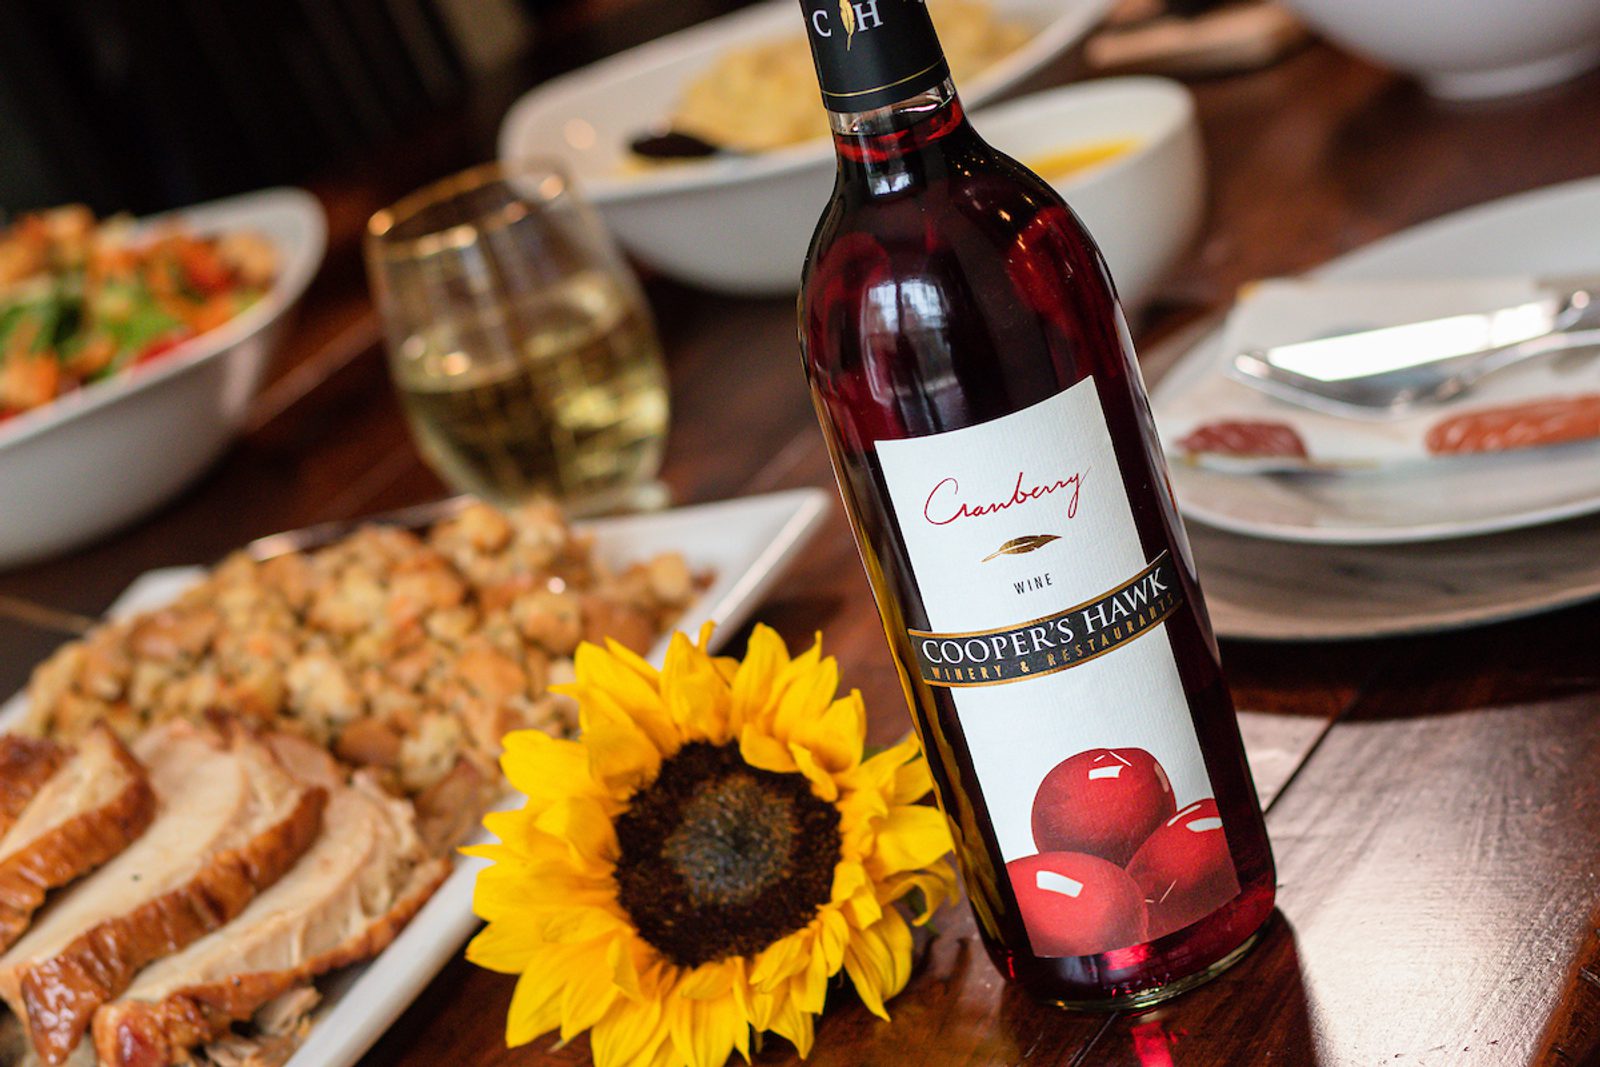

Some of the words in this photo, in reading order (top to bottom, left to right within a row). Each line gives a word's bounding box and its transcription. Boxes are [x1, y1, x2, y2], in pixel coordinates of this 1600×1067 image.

[812, 9, 832, 38] C
[852, 0, 884, 32] H
[924, 466, 1091, 525] Cranberry
[1013, 572, 1053, 595] WINE
[922, 618, 1075, 664] COOPER'S
[1081, 567, 1168, 634] HAWK
[931, 665, 1003, 682] WINERY
[1019, 660, 1030, 673] &
[1047, 592, 1175, 666] RESTAURANTS
